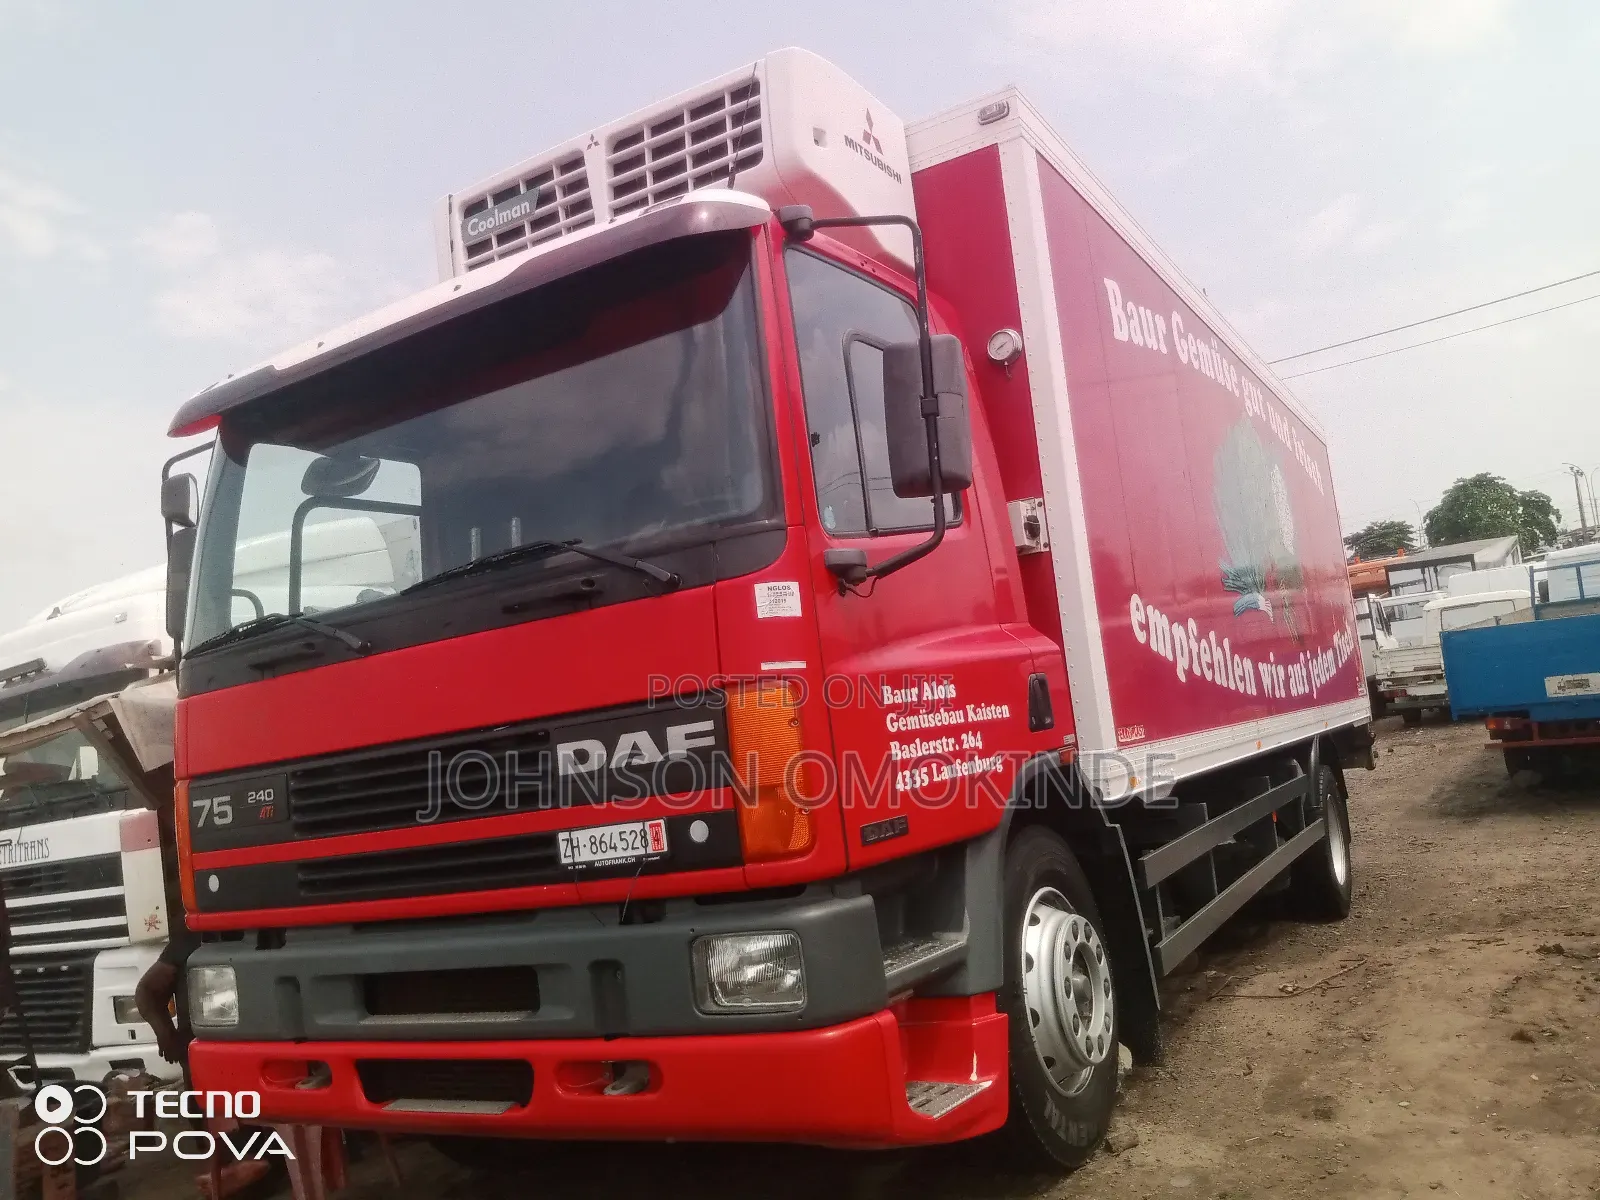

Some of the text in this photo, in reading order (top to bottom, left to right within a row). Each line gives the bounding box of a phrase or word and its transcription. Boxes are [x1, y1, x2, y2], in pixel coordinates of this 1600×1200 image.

[844, 135, 902, 185] MITSUBISHI
[467, 201, 531, 236] Coolman
[1103, 277, 1168, 354] Baur
[1171, 311, 1240, 397] Gemüse
[1241, 375, 1266, 421] gut
[1129, 593, 1257, 696] empfehlen
[1258, 651, 1286, 698] wir
[1287, 651, 1310, 697] auf
[1306, 645, 1337, 700] jedem
[881, 680, 957, 705] Baur Alois
[886, 703, 1010, 733] Gemüsebau Kaisten
[556, 720, 716, 776] DAF
[889, 731, 983, 761] Baslerstr. 264
[895, 754, 1004, 792] 4335 Laufenburg
[192, 795, 233, 828] 75
[247, 788, 274, 803] 240
[0, 837, 50, 864] TRITRANS
[594, 857, 636, 867] AUTOFRANK.CH
